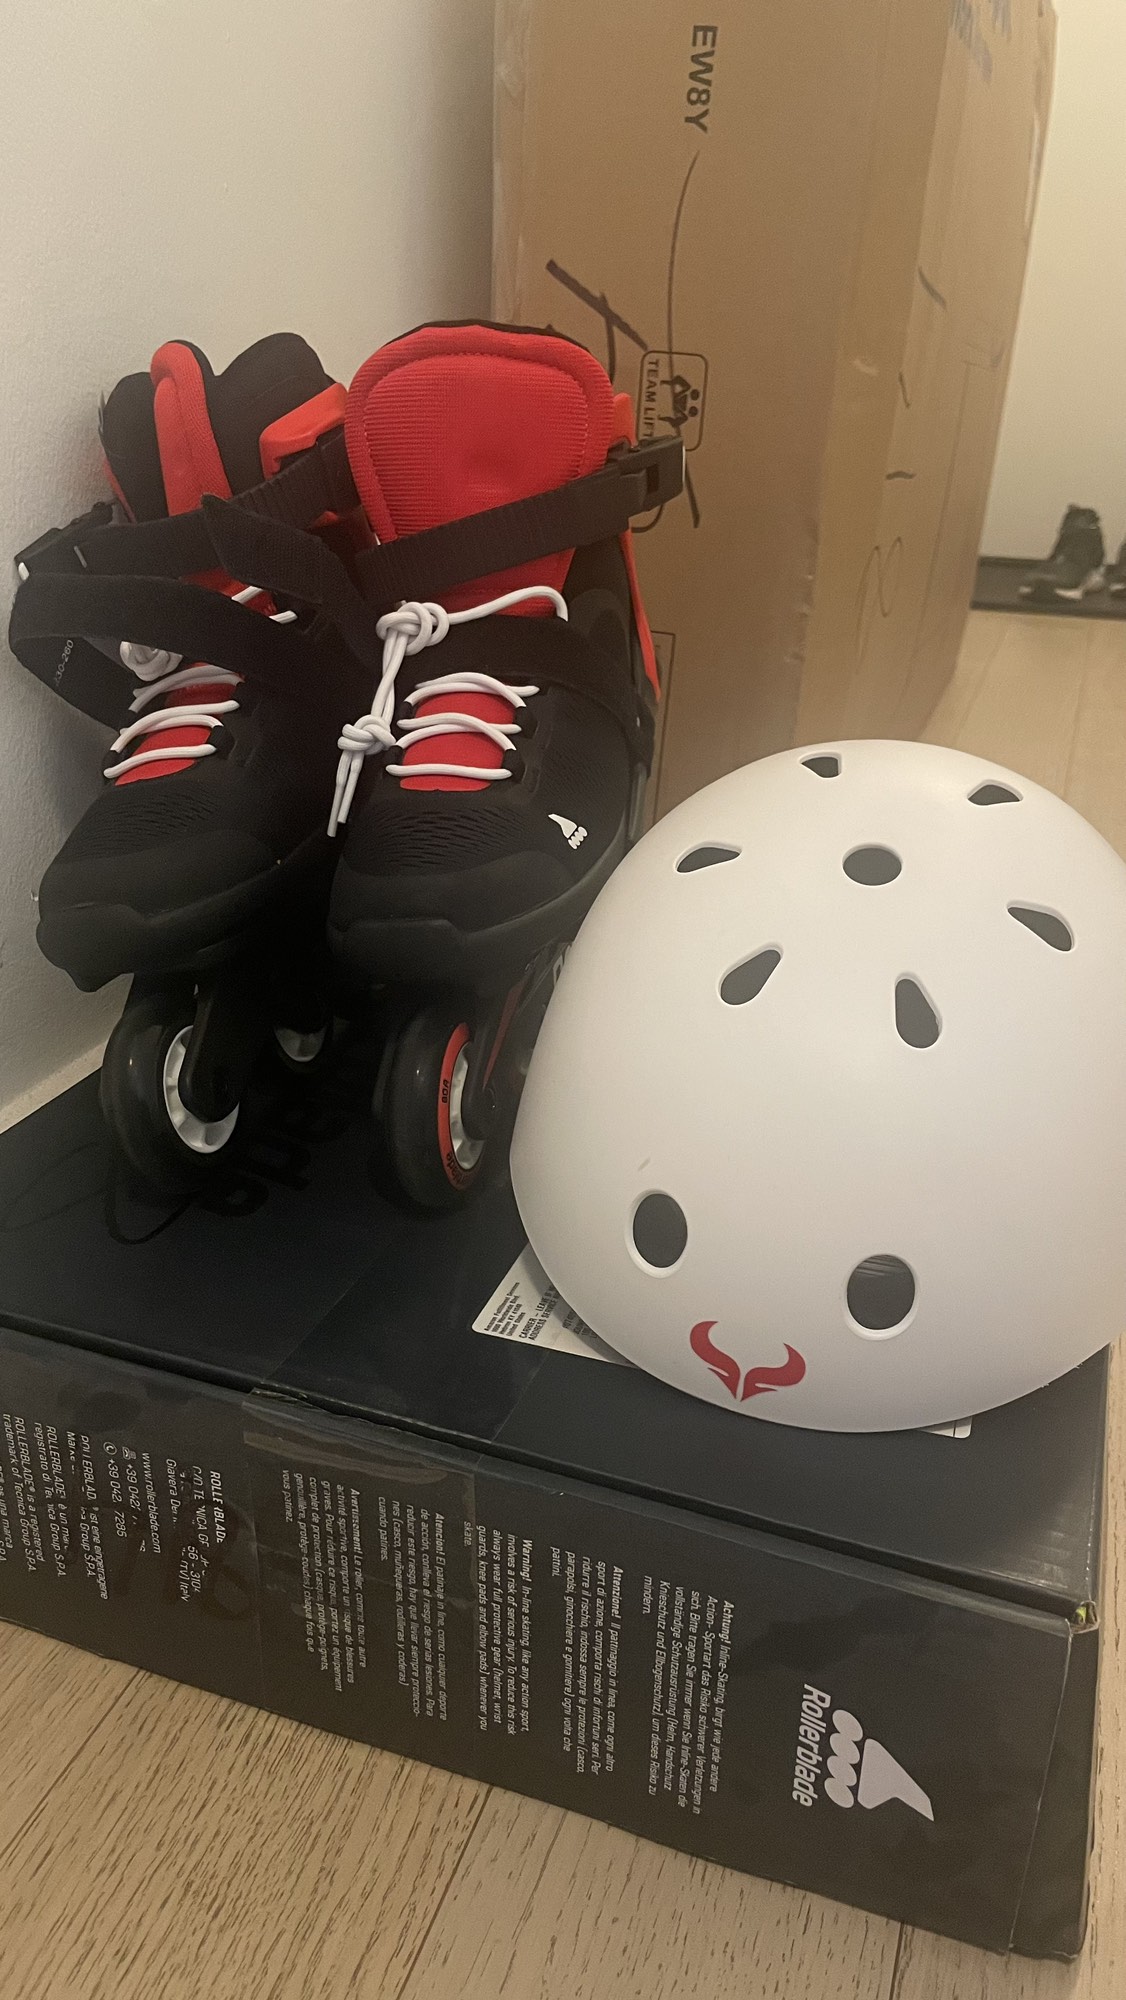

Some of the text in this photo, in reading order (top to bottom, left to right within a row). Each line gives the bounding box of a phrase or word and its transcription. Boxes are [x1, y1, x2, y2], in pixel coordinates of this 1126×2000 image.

[684, 24, 718, 134] EW8Y
[644, 359, 660, 404] TEAM
[3, 1414, 18, 1465] trademark
[11, 1467, 22, 1478] of
[166, 1459, 177, 1496] Giavera
[14, 1482, 26, 1515] Tecnica
[27, 1494, 34, 1502] is
[34, 1422, 48, 1470] registrato
[42, 1473, 52, 1482] di
[50, 1523, 60, 1551] Group
[142, 1453, 161, 1553] www.rollerblade.com
[59, 1512, 68, 1524] un
[90, 1513, 98, 1524] ist
[20, 1518, 31, 1547] Group
[30, 1512, 44, 1562] registered
[80, 1523, 90, 1551] Group
[91, 1526, 100, 1544] eine
[435, 1513, 445, 1555] Atencion!
[491, 1530, 503, 1561] always
[507, 1534, 518, 1568] involves
[436, 1556, 446, 1565] El
[520, 1540, 532, 1582] Warning!
[582, 1556, 592, 1588] ridurre
[434, 1566, 444, 1599] patinaje
[507, 1577, 517, 1594] risk
[595, 1561, 606, 1586] sport
[493, 1587, 503, 1603] full
[507, 1596, 517, 1607] of
[522, 1586, 532, 1613] In-line
[597, 1587, 607, 1597] di
[611, 1566, 624, 1619] Attenzione!
[437, 1601, 444, 1609] in
[657, 1580, 670, 1630] Knieschutz
[670, 1587, 685, 1638] vollständige
[706, 1595, 718, 1628] Action-
[476, 1526, 490, 1730] guards, knee pads and elbow pads) whenever you
[491, 1602, 501, 1645] protective
[507, 1607, 515, 1637] serious
[564, 1596, 576, 1644] ginocchiere
[689, 1612, 700, 1633] Bitte
[718, 1600, 734, 1644] Achtung!
[580, 1630, 590, 1663] indossa
[592, 1630, 603, 1670] comporta
[656, 1631, 666, 1649] und
[685, 1635, 697, 1663] tragen
[702, 1631, 715, 1669] Sportart
[491, 1647, 501, 1666] gear
[522, 1649, 531, 1664] like
[607, 1629, 618, 1677] pattinaggio
[508, 1666, 517, 1674] To
[519, 1666, 529, 1682] any
[562, 1654, 575, 1697] gomitiere)
[577, 1664, 587, 1696] sempre
[609, 1678, 616, 1686] in
[666, 1640, 682, 1716] Schutzausrüstung
[686, 1664, 697, 1678] Sie
[701, 1670, 712, 1686] das
[507, 1675, 516, 1702] reduce
[521, 1683, 529, 1708] action
[594, 1672, 603, 1696] rischi
[684, 1679, 693, 1707] immer
[507, 1704, 517, 1719] this
[562, 1698, 571, 1715] ogni
[593, 1697, 603, 1706] di
[699, 1688, 711, 1713] Risiko
[507, 1720, 516, 1735] risk
[576, 1705, 586, 1745] protezioni
[592, 1706, 603, 1741] infortuni
[607, 1711, 615, 1733] come
[652, 1718, 659, 1732] um
[683, 1708, 691, 1730] wenn
[563, 1737, 572, 1752] che
[604, 1735, 614, 1752] ogni
[651, 1733, 661, 1759] dieses
[682, 1731, 692, 1744] Sie
[697, 1715, 709, 1754] schwerer
[713, 1729, 721, 1744] wie
[792, 1684, 832, 1808] Rollerblade
[606, 1753, 615, 1771] altro
[710, 1744, 721, 1763] jede
[591, 1760, 601, 1775] Per
[649, 1760, 660, 1784] Risiko
[710, 1764, 719, 1792] andere
[649, 1785, 656, 1795] zu
[678, 1795, 688, 1807] die
[693, 1806, 700, 1814] in
